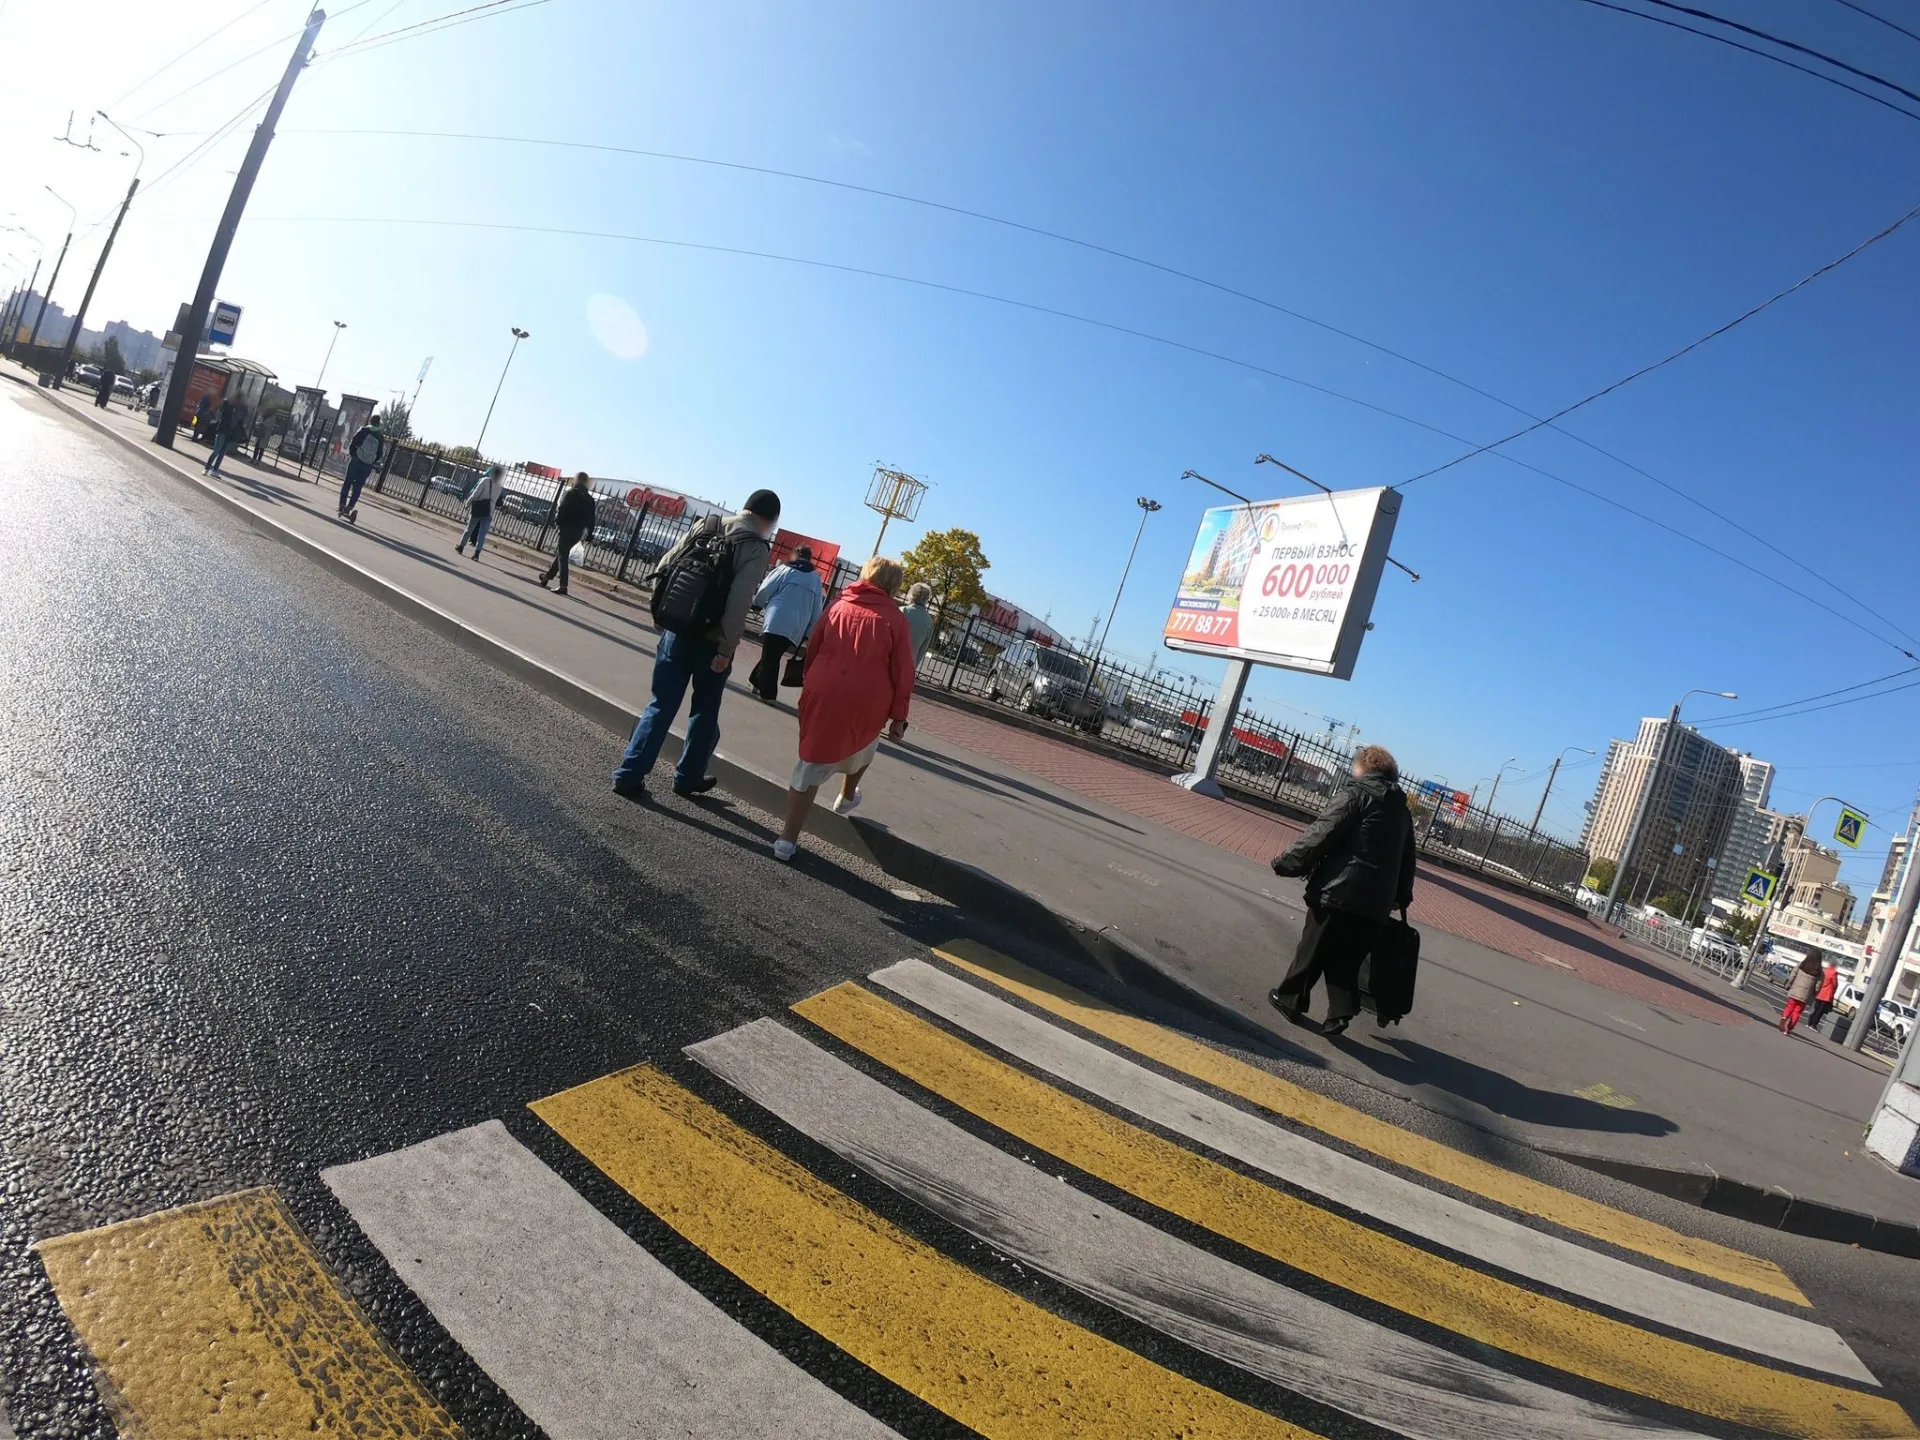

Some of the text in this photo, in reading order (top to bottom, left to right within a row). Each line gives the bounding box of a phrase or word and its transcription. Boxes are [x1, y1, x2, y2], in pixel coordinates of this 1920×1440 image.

[1272, 543, 1358, 560] ПЕРВЫЙ ВЗНОС
[1262, 563, 1350, 598] 600 000
[1309, 587, 1344, 601] рублей
[1171, 612, 1198, 632] 777
[1194, 614, 1214, 634] 88
[1211, 616, 1233, 636] 77
[1292, 607, 1300, 620] В
[1299, 608, 1338, 624] МЕСЯЦ
